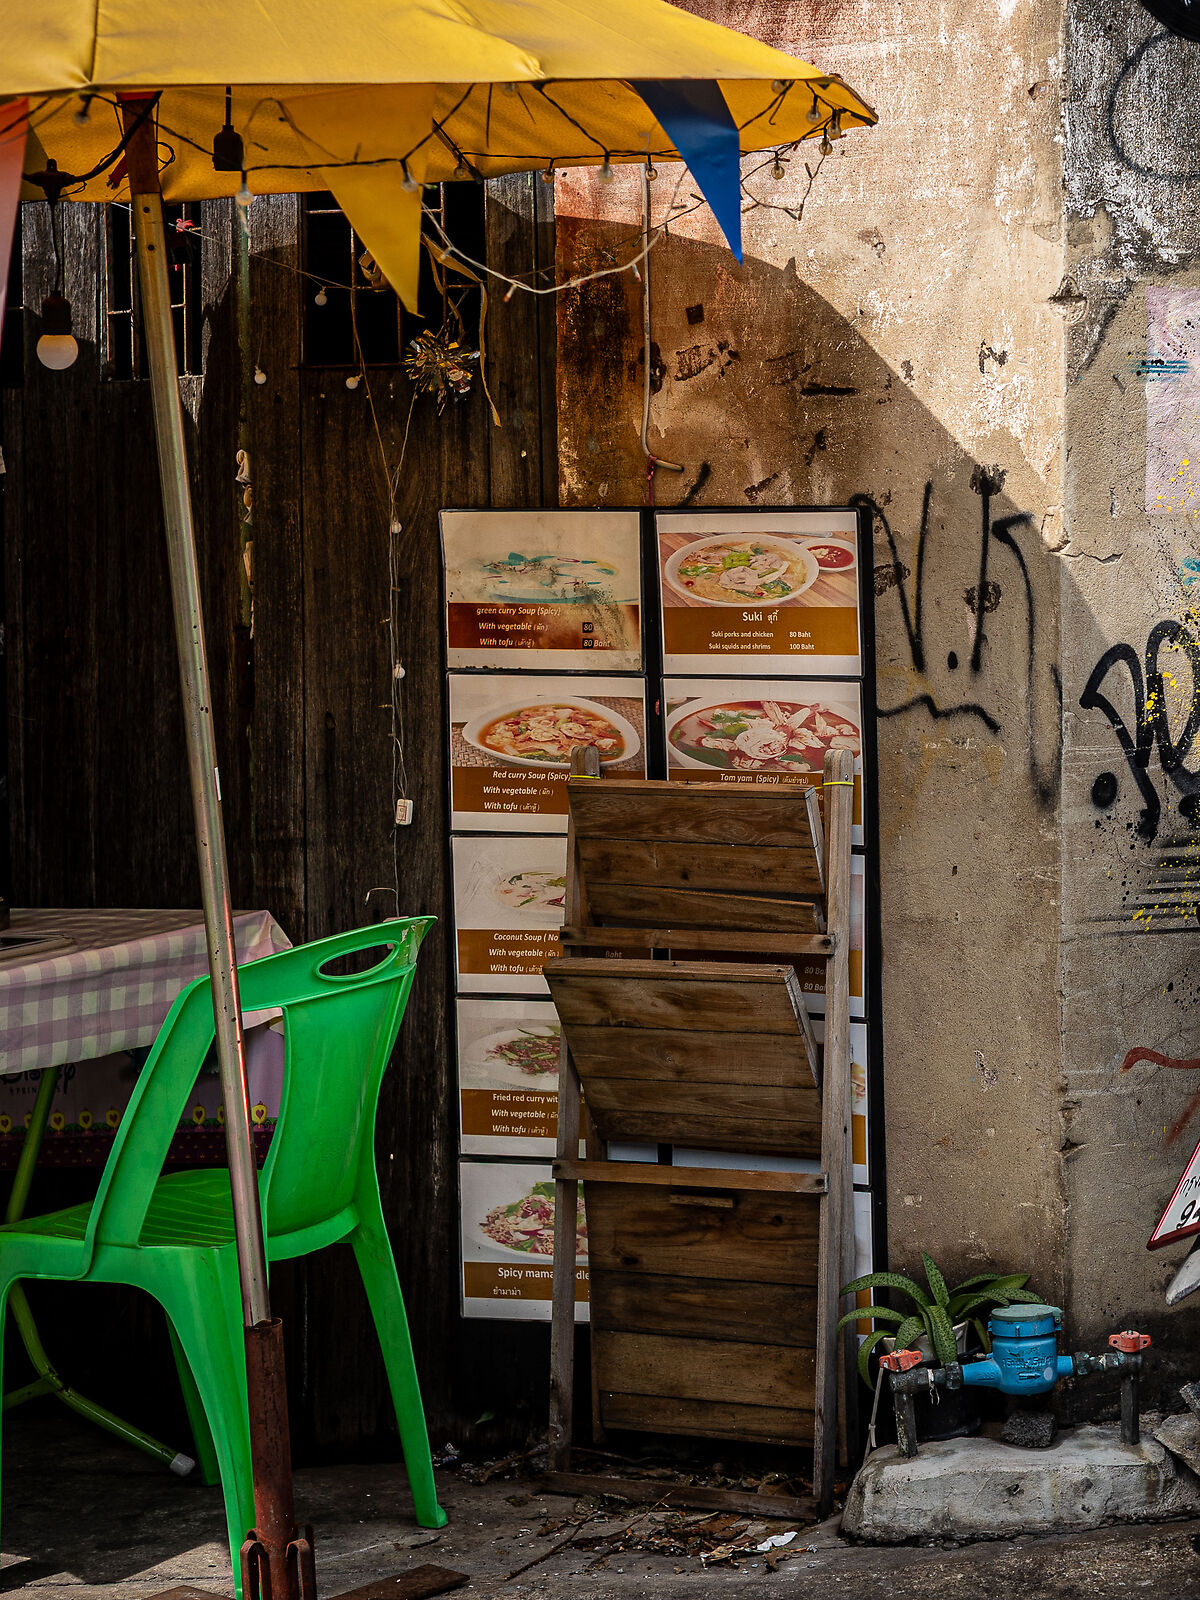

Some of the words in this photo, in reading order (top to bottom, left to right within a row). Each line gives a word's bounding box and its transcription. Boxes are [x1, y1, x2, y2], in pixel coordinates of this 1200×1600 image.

[476, 607, 497, 615] green
[498, 608, 517, 616] curry
[518, 607, 535, 616] Soup
[742, 611, 763, 622] Suki
[478, 622, 496, 630] With
[497, 623, 532, 632] vegetable
[583, 623, 593, 631] 80
[724, 631, 740, 639] porks
[479, 638, 497, 646] With
[498, 638, 514, 647] tofu
[583, 639, 593, 647] 80
[594, 639, 610, 647] Baht
[721, 643, 740, 651] squids
[492, 770, 507, 778] Red
[508, 772, 527, 780] curry
[527, 771, 546, 780] Soup
[720, 773, 736, 781] Tom
[736, 775, 753, 783] yam
[755, 774, 780, 784] (Spicy)
[483, 786, 501, 794] With
[501, 786, 537, 796] vegetable
[484, 801, 501, 810] With
[503, 802, 518, 811] tofu
[493, 932, 523, 941] Coconut
[524, 933, 542, 942] Soup
[508, 949, 543, 958] vegetable
[490, 964, 508, 972] With
[509, 964, 524, 974] tofu
[805, 967, 814, 975] 80
[804, 983, 813, 991] 80
[493, 1093, 511, 1102] Fried
[512, 1094, 524, 1102] red
[526, 1095, 545, 1104] curry
[491, 1109, 509, 1117] With
[510, 1110, 546, 1119] vegetable
[492, 1125, 510, 1133] With
[511, 1125, 526, 1134] tofu
[497, 1267, 523, 1279] Spicy
